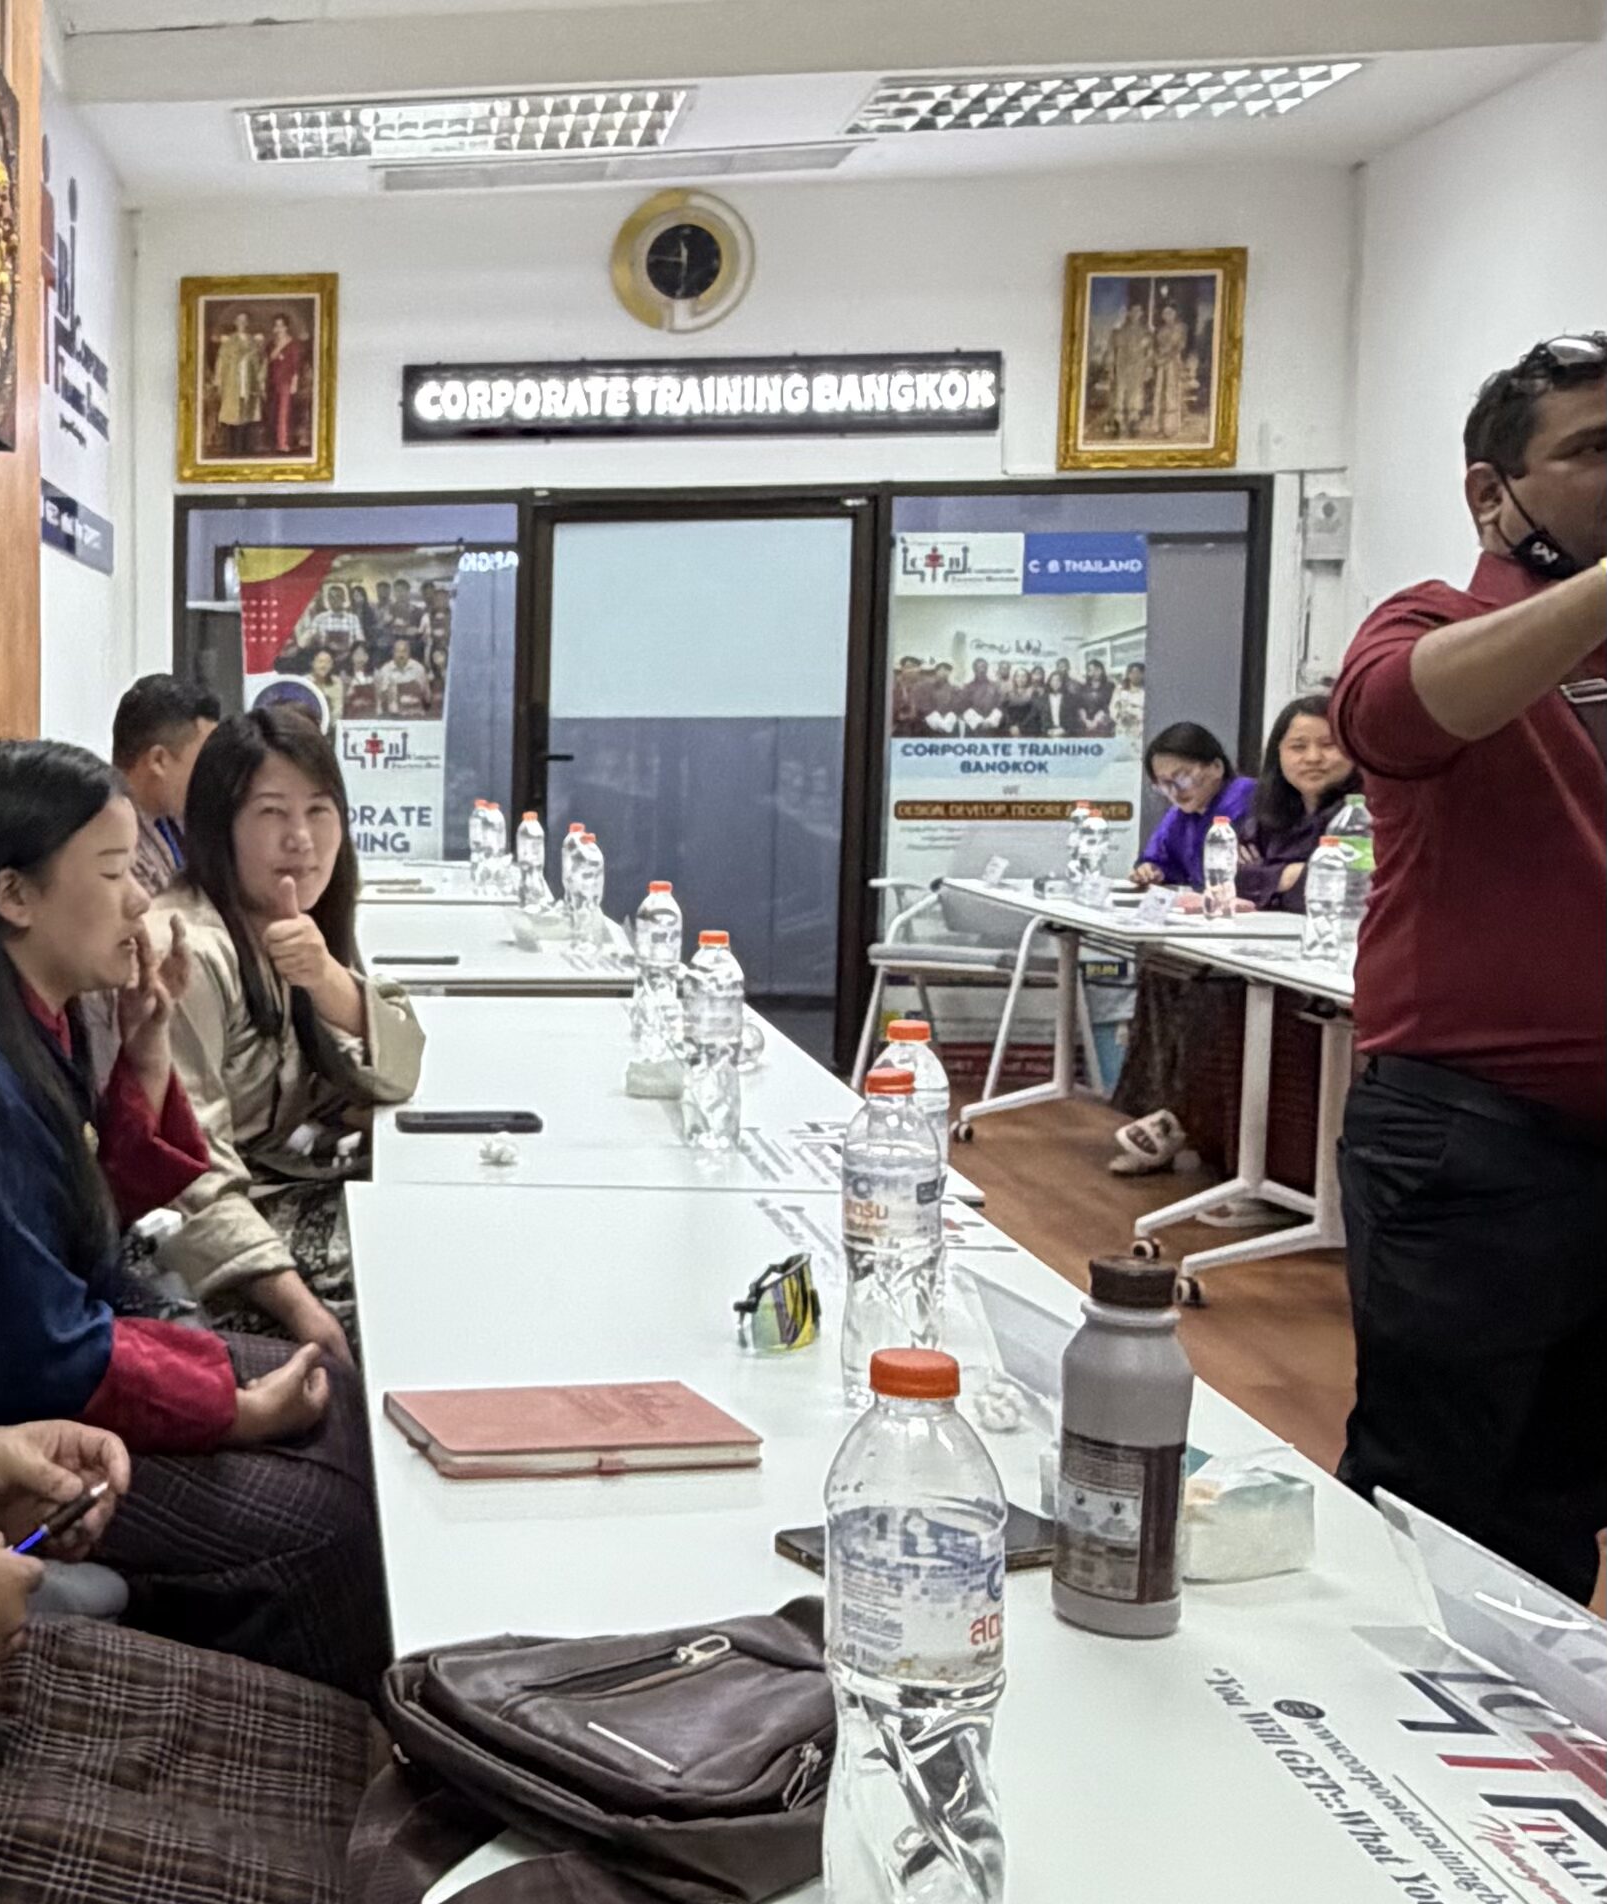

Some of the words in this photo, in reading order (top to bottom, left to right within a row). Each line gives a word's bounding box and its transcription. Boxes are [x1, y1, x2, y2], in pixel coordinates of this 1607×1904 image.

[415, 377, 631, 421] CORPORATE
[633, 374, 808, 417] TRAINING
[811, 369, 996, 414] BANGKOK
[900, 742, 1012, 757] CORPORATE
[1017, 742, 1105, 758] TRAINING
[959, 760, 1049, 775] BANGKOK
